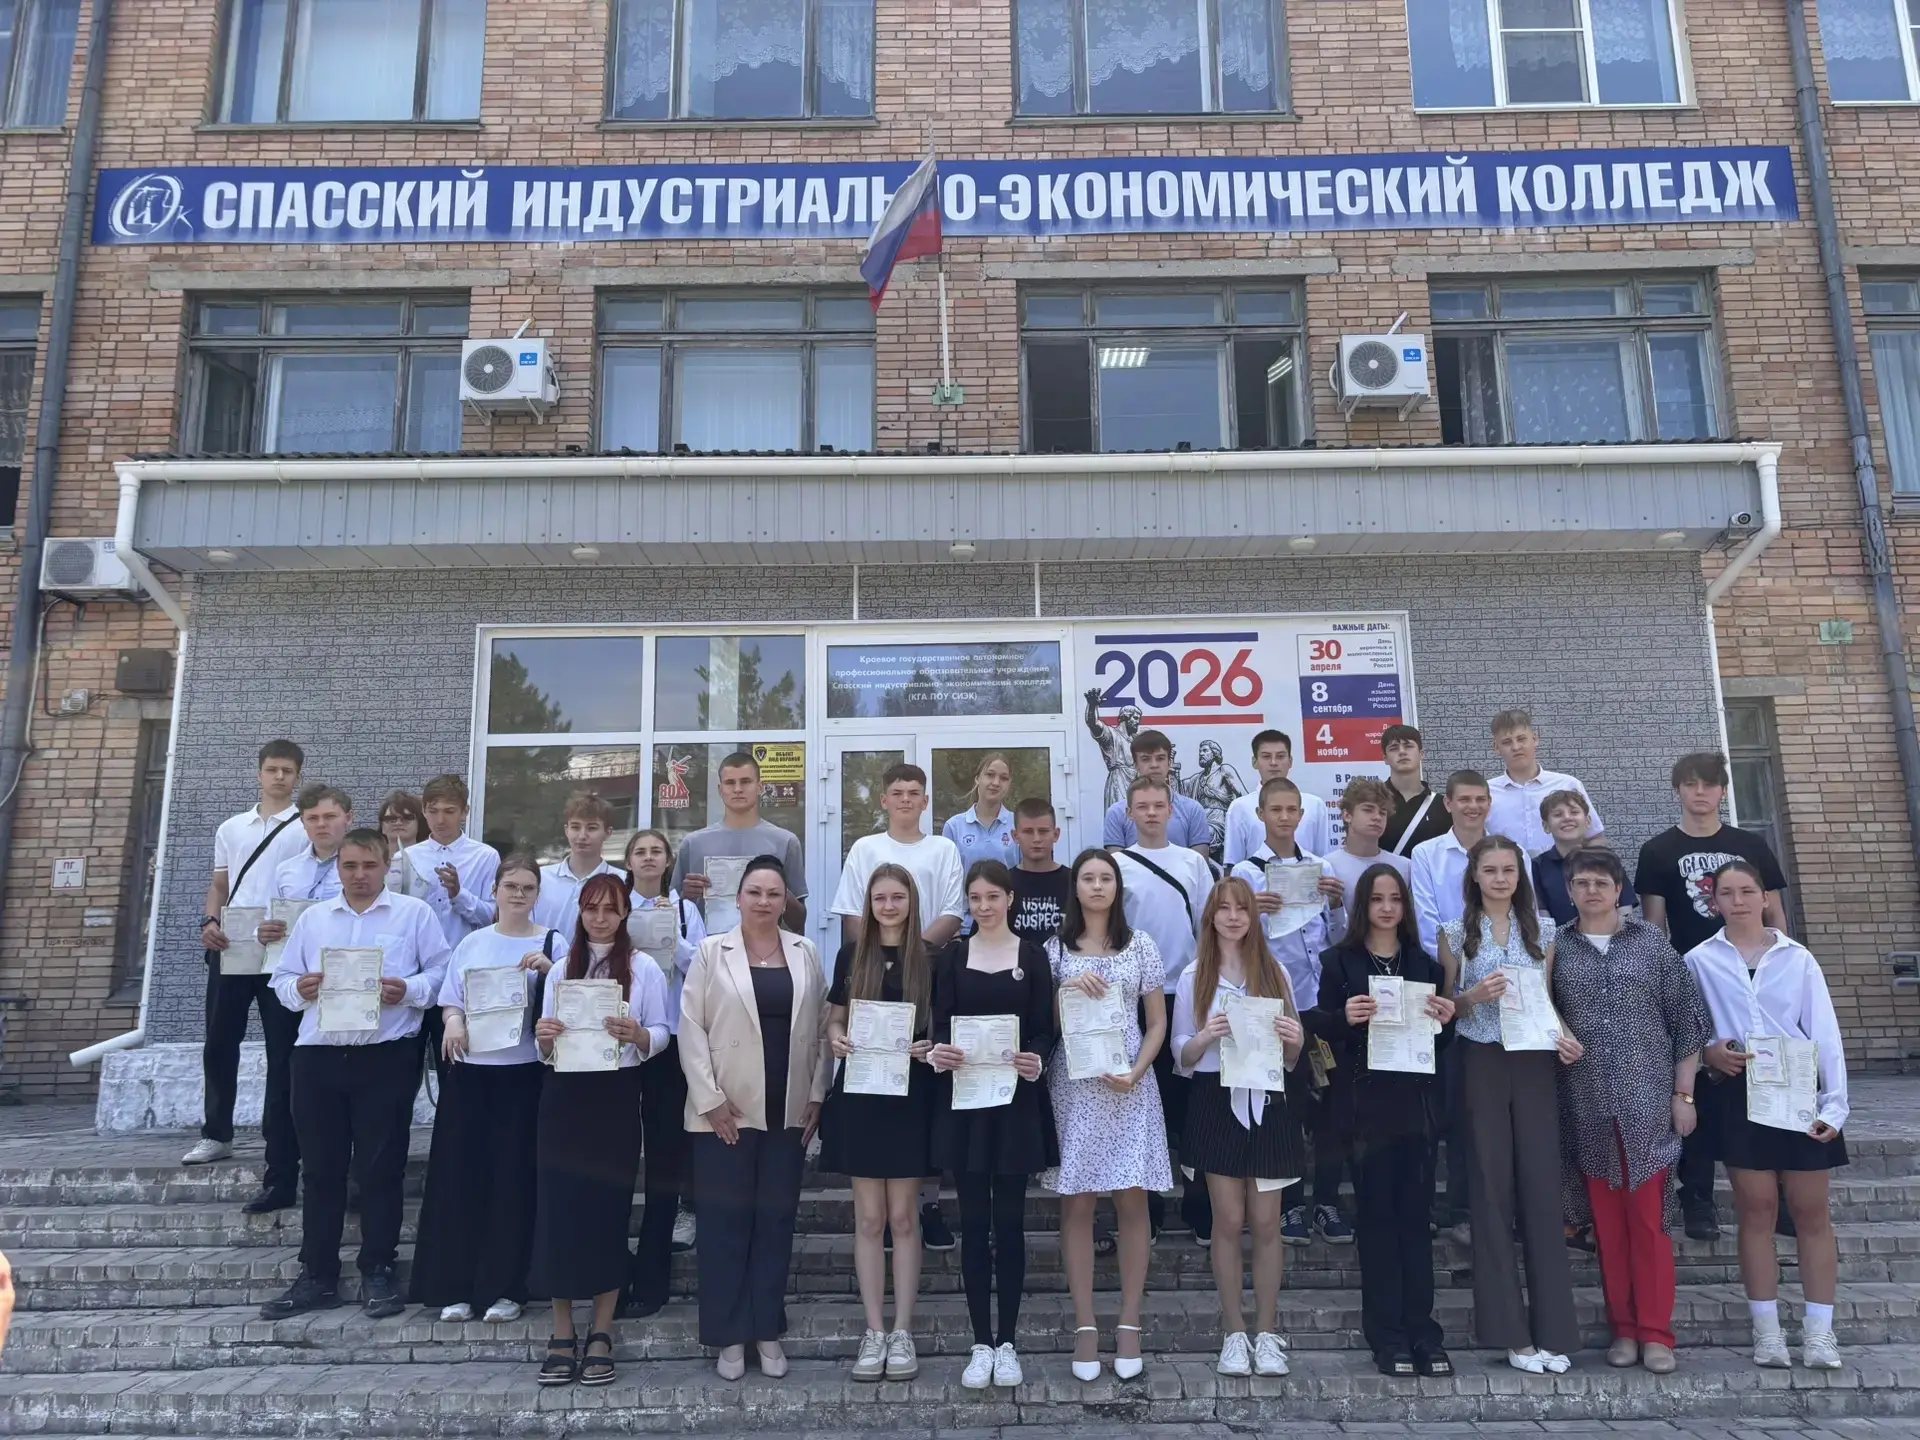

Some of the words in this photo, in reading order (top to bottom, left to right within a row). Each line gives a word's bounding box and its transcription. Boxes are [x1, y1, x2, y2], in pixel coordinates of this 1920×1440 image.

[202, 168, 489, 230] СПАССКИЙ
[510, 155, 1478, 233] ИНДУСТРИАЛЬО-ЭКОНОМИЧЕСКИЙ
[1495, 160, 1776, 215] КОЛЛЕДЖ
[1332, 623, 1365, 631] ВАЖНЫЕ
[1366, 622, 1391, 632] ДАТЫ:
[1309, 639, 1342, 660] 30
[860, 655, 896, 664] Краевое
[899, 654, 970, 663] государственное
[835, 668, 917, 677] профессиональное
[919, 666, 994, 676] образовательное
[996, 666, 1050, 675] учреждение
[1310, 662, 1342, 673] апреля
[1094, 649, 1263, 708] 2026
[874, 681, 943, 690] индустриально-
[946, 679, 1011, 687] экономический
[1014, 679, 1053, 687] колледж
[908, 693, 928, 702] (КГА
[930, 692, 949, 700] ПОУ
[951, 692, 978, 701] СИЭК)
[1311, 682, 1329, 703] 8
[1312, 704, 1353, 714] сентября
[1316, 724, 1334, 745] 4
[1317, 747, 1349, 757] ноября
[1335, 774, 1342, 783] В
[659, 784, 676, 798] 80
[658, 799, 689, 808] ПОБЕДА!
[1022, 899, 1060, 913] USUAL
[1014, 912, 1067, 931] SUSPECT
